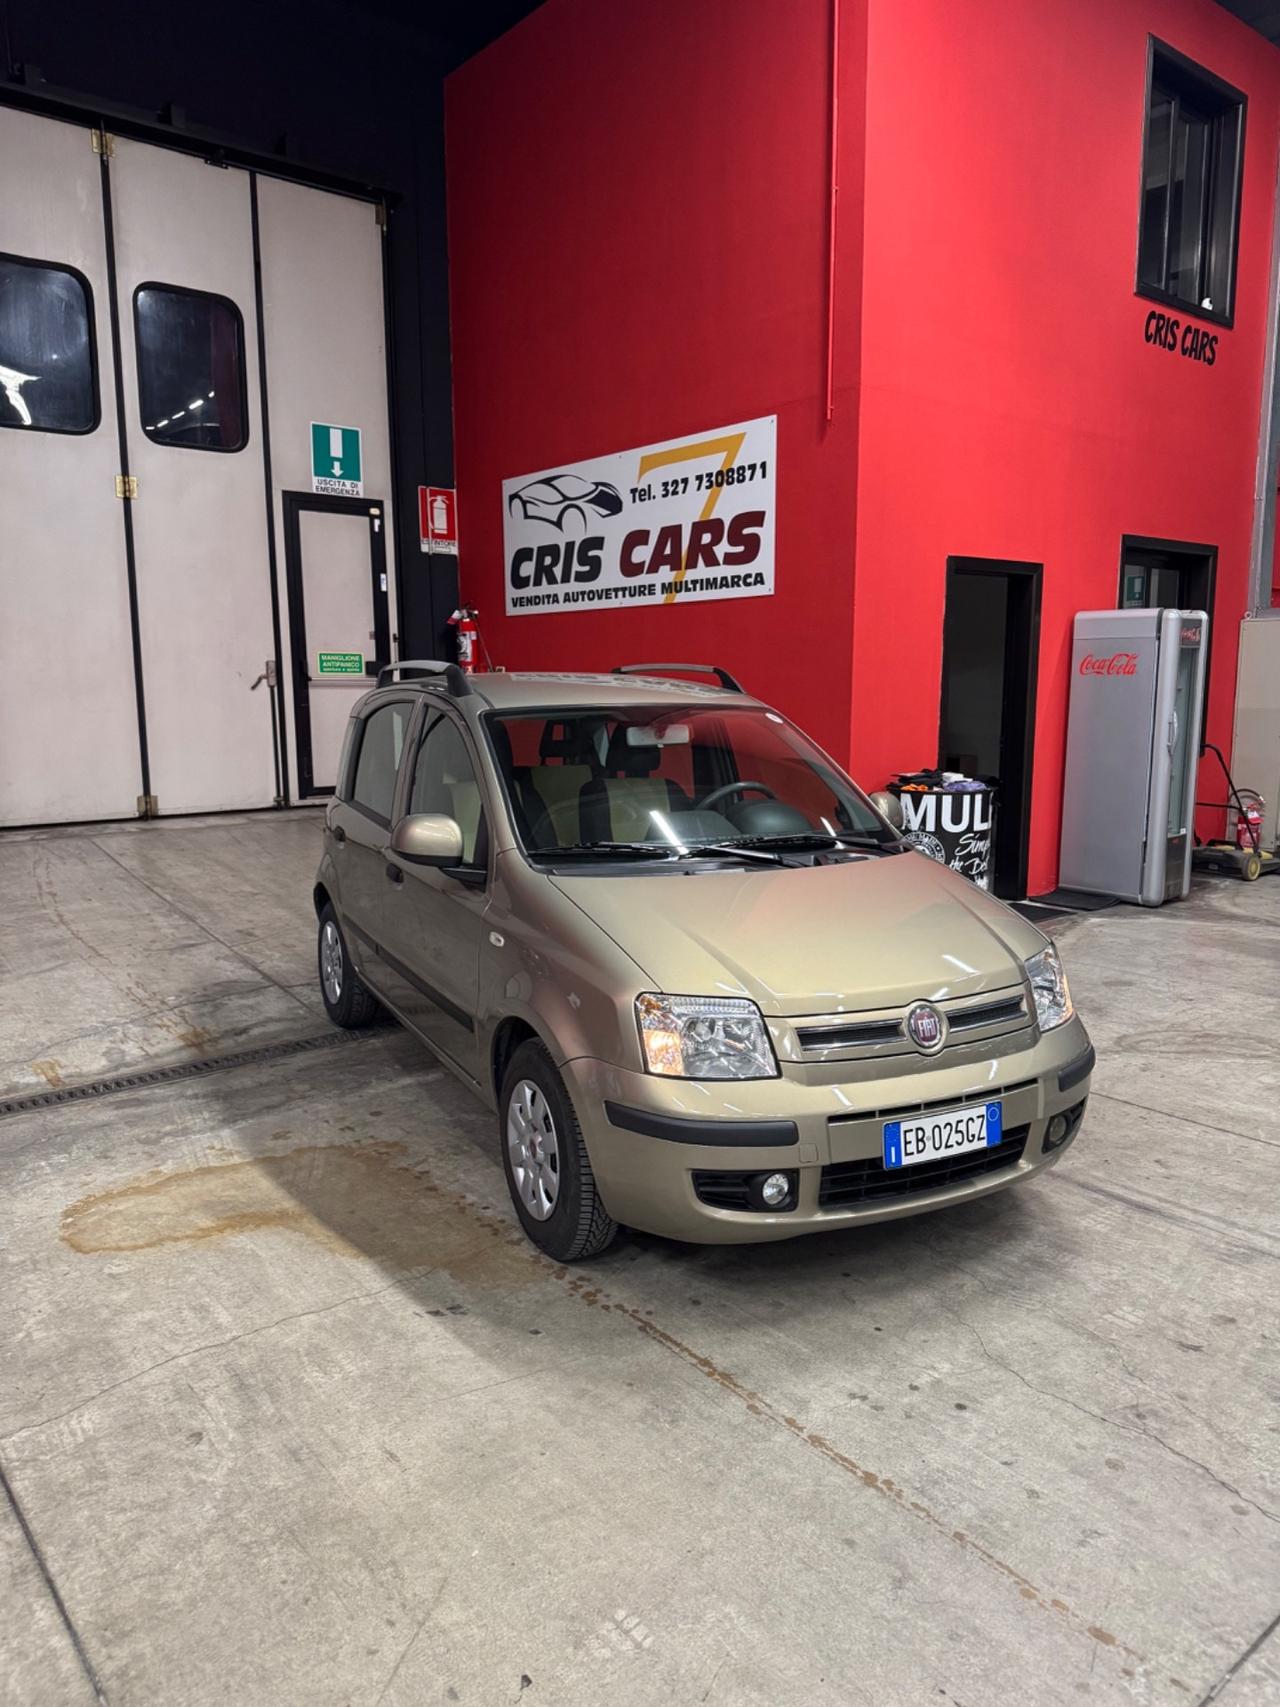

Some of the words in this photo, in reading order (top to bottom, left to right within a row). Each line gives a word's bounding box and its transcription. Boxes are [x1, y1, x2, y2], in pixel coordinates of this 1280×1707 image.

[1144, 310, 1180, 352] CRIS
[1181, 324, 1218, 366] CARS
[316, 486, 360, 496] EMERGENZA
[318, 480, 346, 488] USCITA
[630, 484, 656, 504] Tel.
[661, 477, 688, 499] 327
[695, 461, 767, 492] 7308871
[510, 536, 605, 590] CRIS
[619, 511, 766, 578] CARS
[511, 594, 560, 608] VENDITA
[563, 584, 656, 603] AUTOVETTURE
[661, 572, 765, 595] MULTIMARCA
[917, 1018, 937, 1038] FIAT
